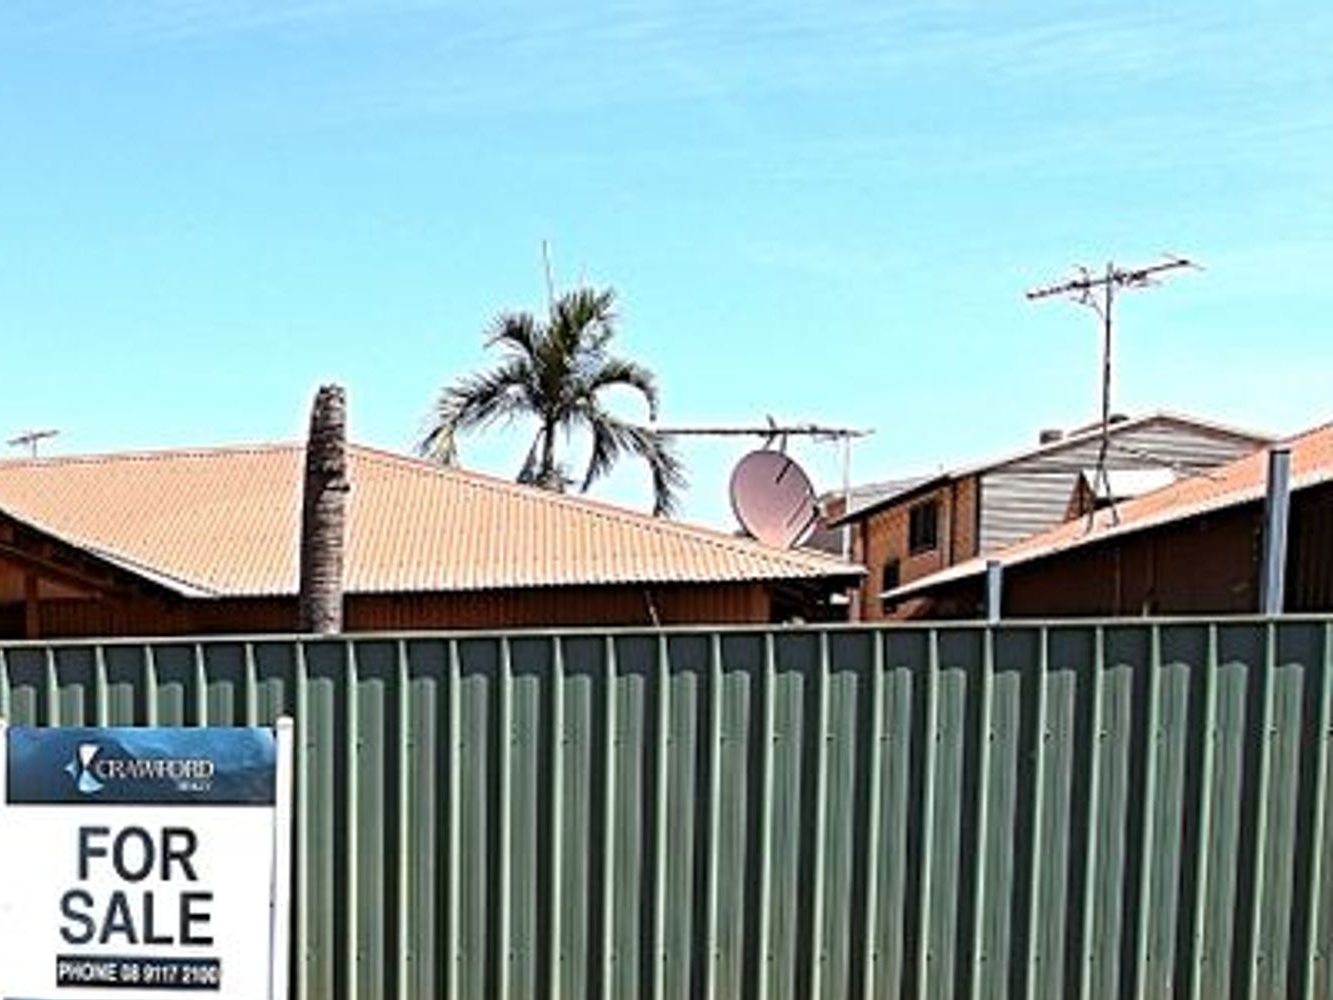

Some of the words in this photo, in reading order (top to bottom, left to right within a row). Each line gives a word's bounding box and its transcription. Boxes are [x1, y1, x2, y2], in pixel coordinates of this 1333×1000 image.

[95, 759, 214, 779] CRAWFORD
[78, 826, 198, 882] FOR
[59, 890, 214, 945] SALE
[58, 961, 117, 982] PHONE
